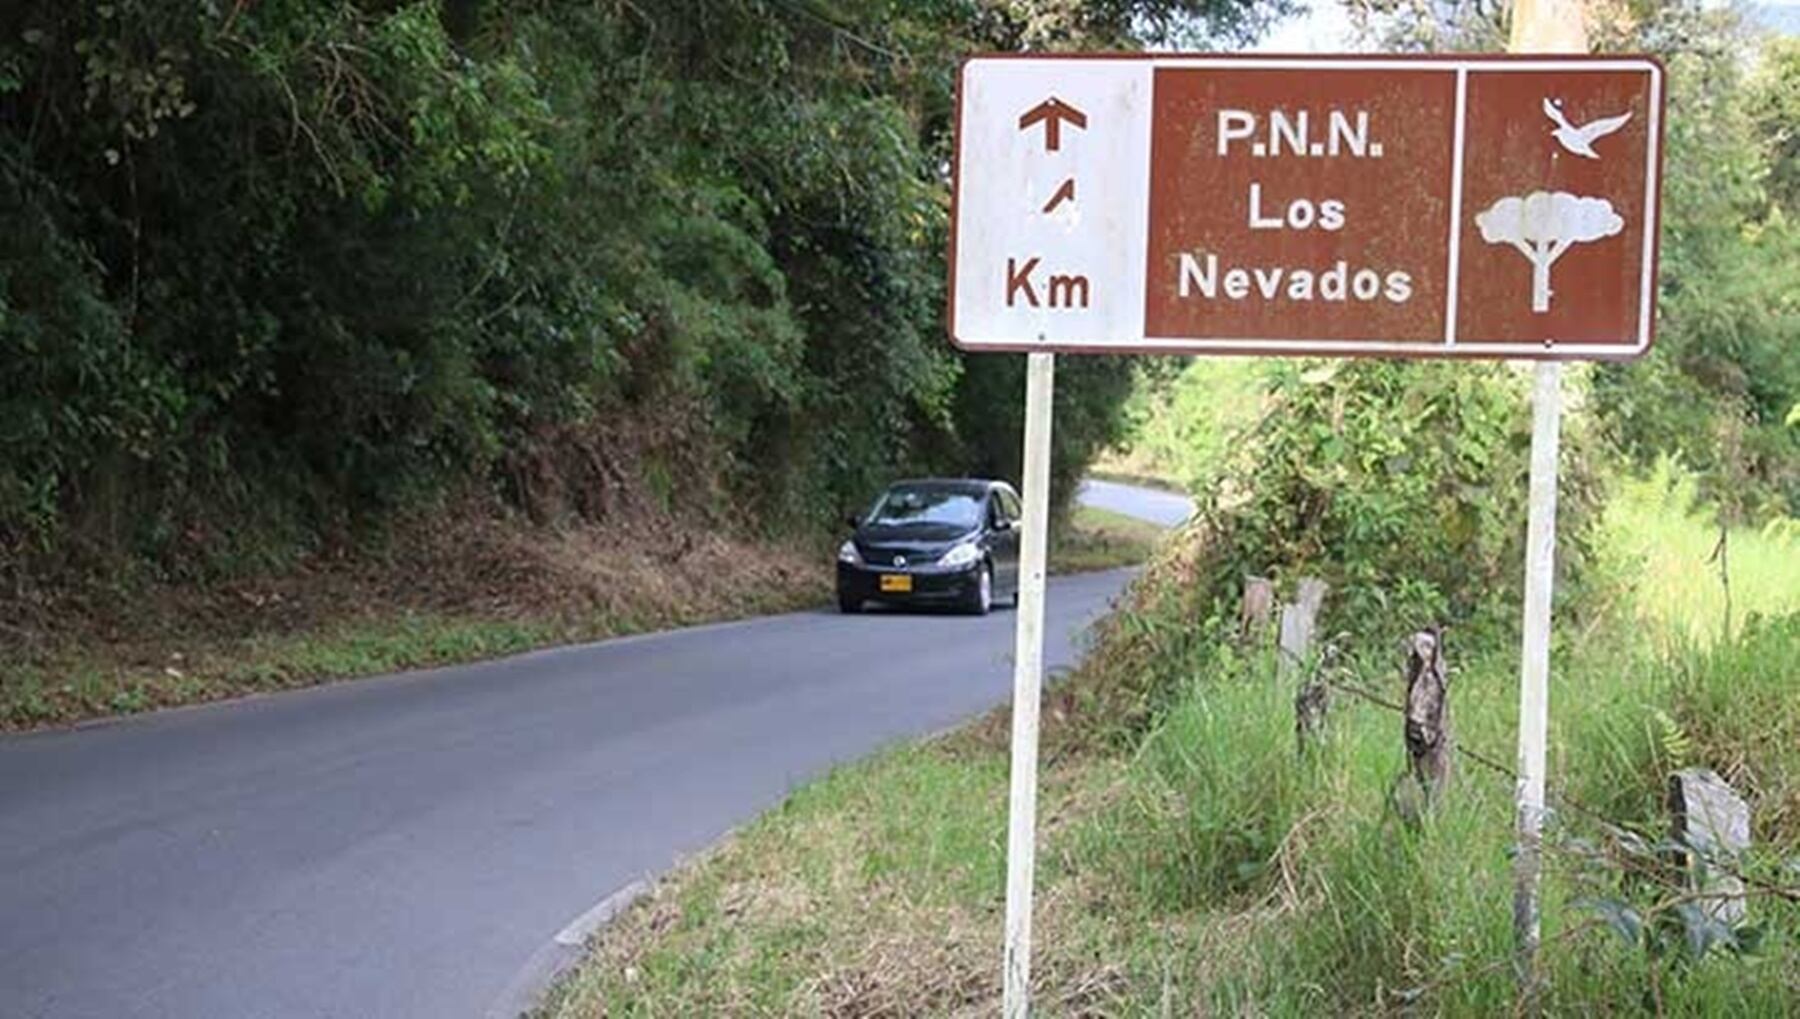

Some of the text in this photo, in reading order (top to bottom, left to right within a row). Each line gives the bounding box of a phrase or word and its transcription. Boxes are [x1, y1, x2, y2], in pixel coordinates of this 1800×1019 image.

[1217, 109, 1384, 157] P.N.N.
[1248, 182, 1346, 230] Los
[1006, 257, 1089, 308] Km
[1178, 252, 1413, 302] Nevados
